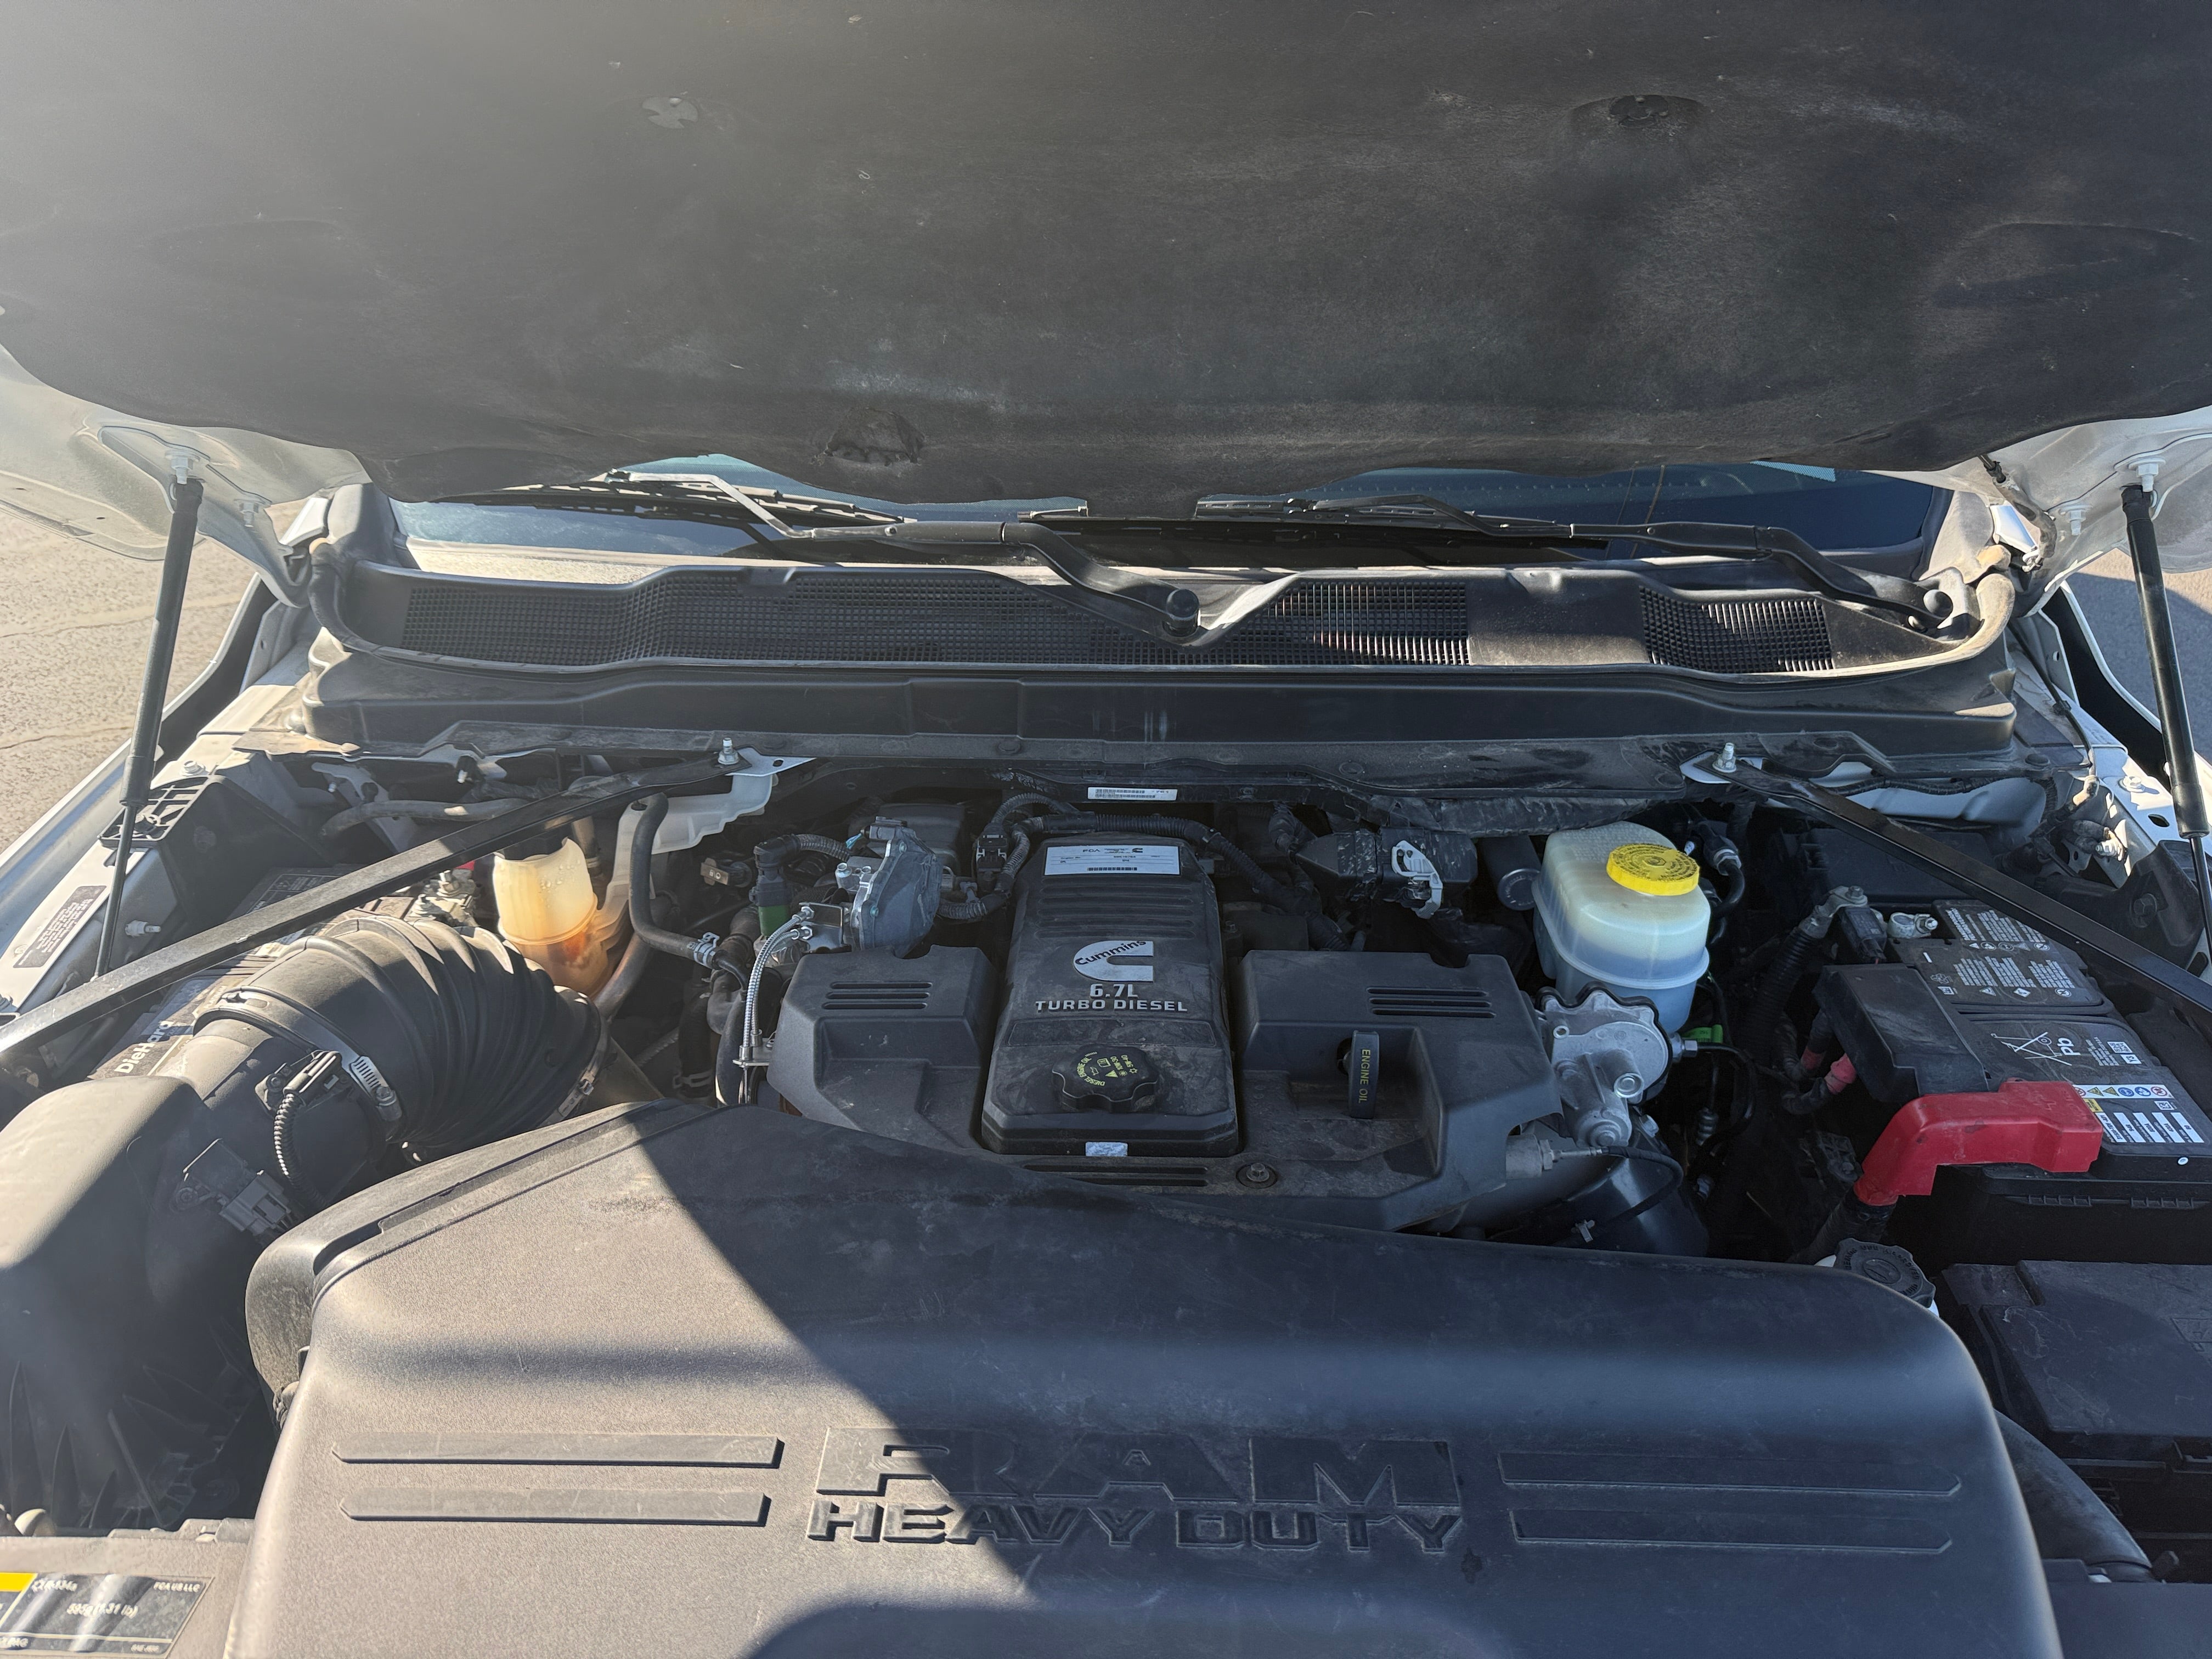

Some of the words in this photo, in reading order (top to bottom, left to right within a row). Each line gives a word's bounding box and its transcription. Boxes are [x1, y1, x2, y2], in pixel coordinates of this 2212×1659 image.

[1075, 940, 1147, 965] Cummins
[1090, 984, 1138, 998] 6.7L
[1036, 1000, 1105, 1011] TURBO
[1114, 1000, 1188, 1012] DIESEL
[114, 1020, 174, 1074] DieHard
[2057, 1038, 2081, 1056] Pb
[1360, 1049, 1371, 1085] ENGINE
[1084, 1076, 1105, 1086] DIESEL
[1358, 1088, 1368, 1104] OIL
[817, 1426, 1462, 1508] RAM
[806, 1500, 1154, 1547] HEAVY
[1176, 1508, 1465, 1553] DUTY
